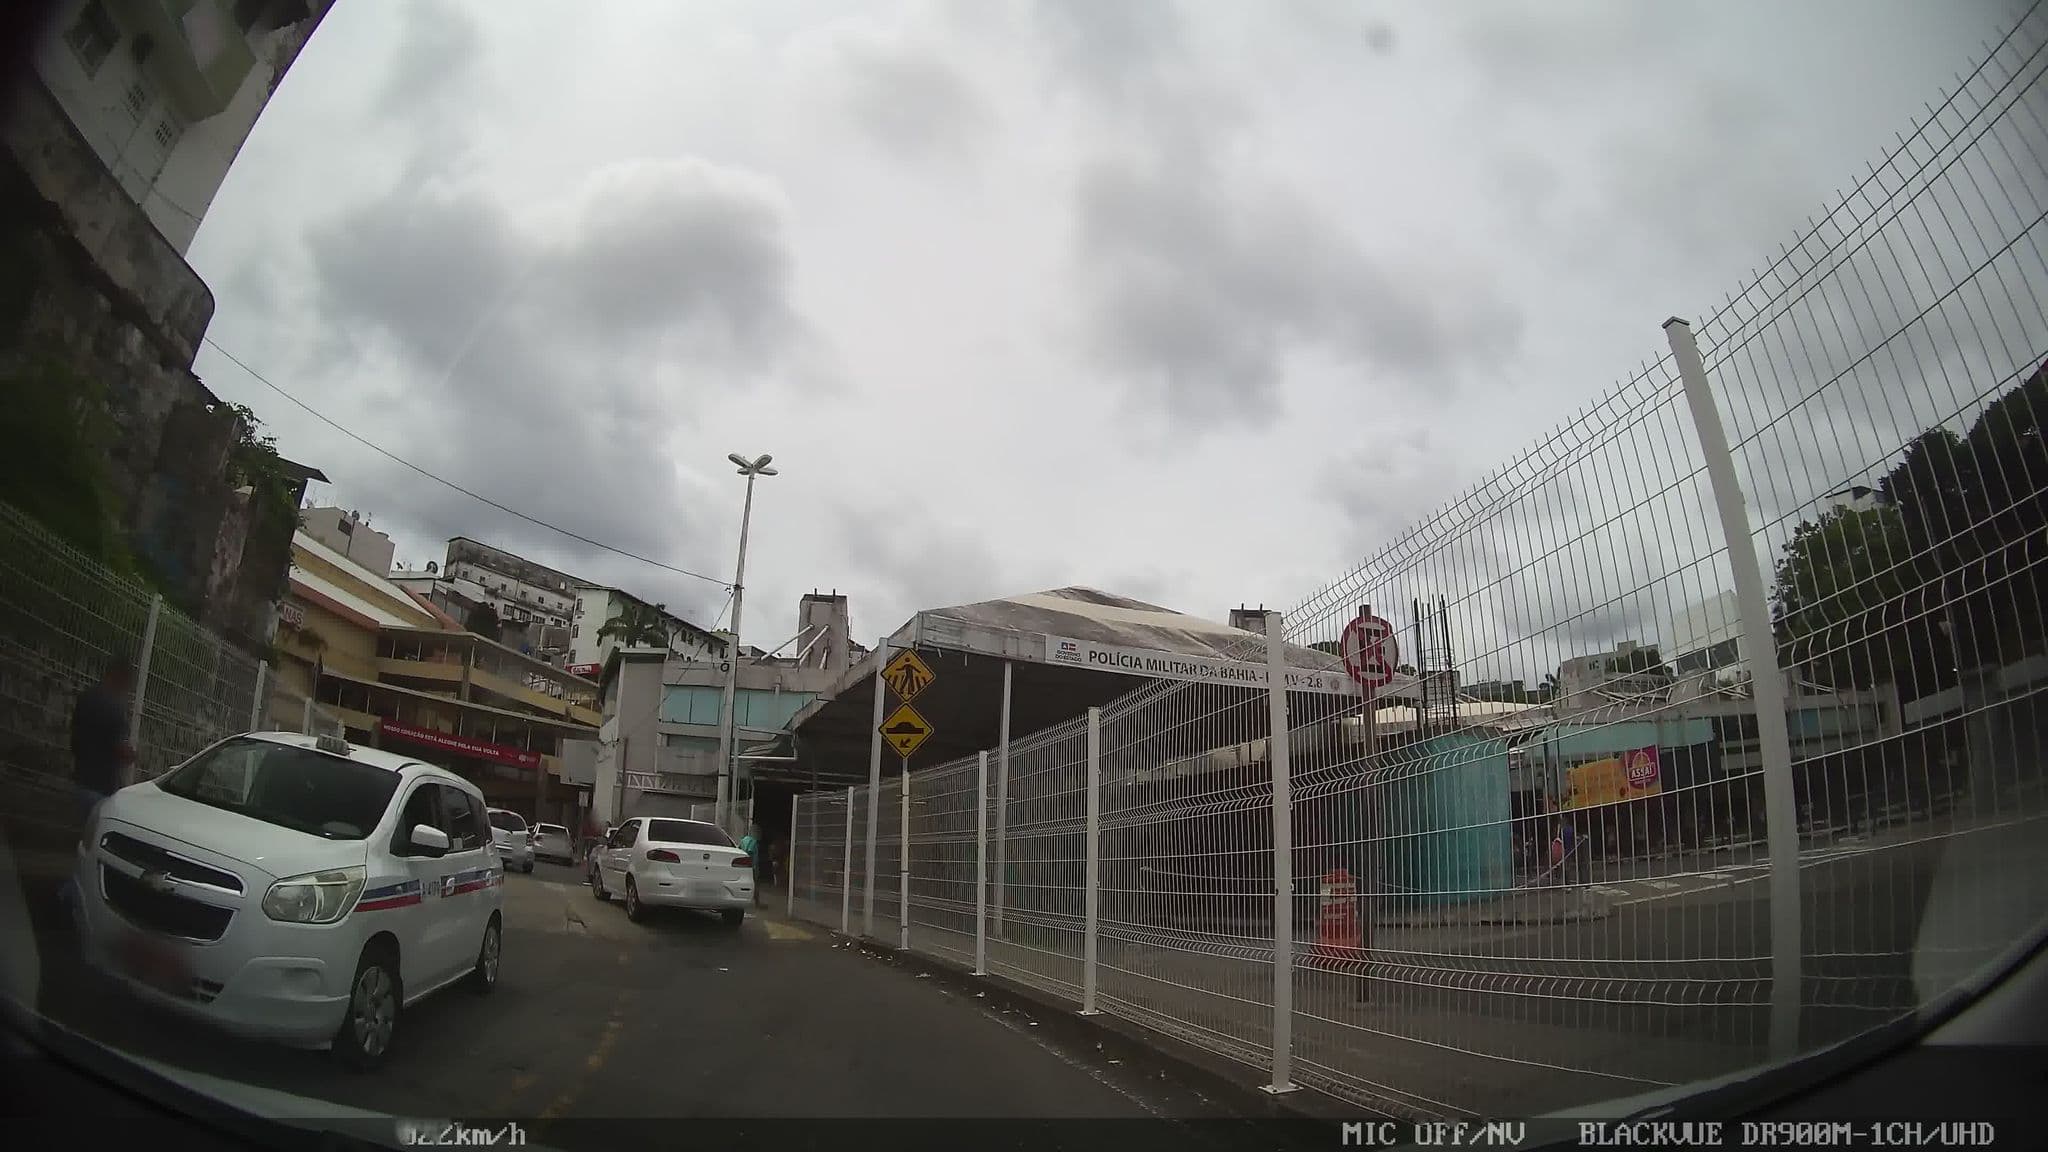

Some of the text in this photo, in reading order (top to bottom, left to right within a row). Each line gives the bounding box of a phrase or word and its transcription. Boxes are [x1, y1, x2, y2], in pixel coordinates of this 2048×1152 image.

[1089, 650, 1143, 669] POLÍCIA
[1146, 658, 1198, 676] MILITAR
[1220, 666, 1257, 683] BAHIA
